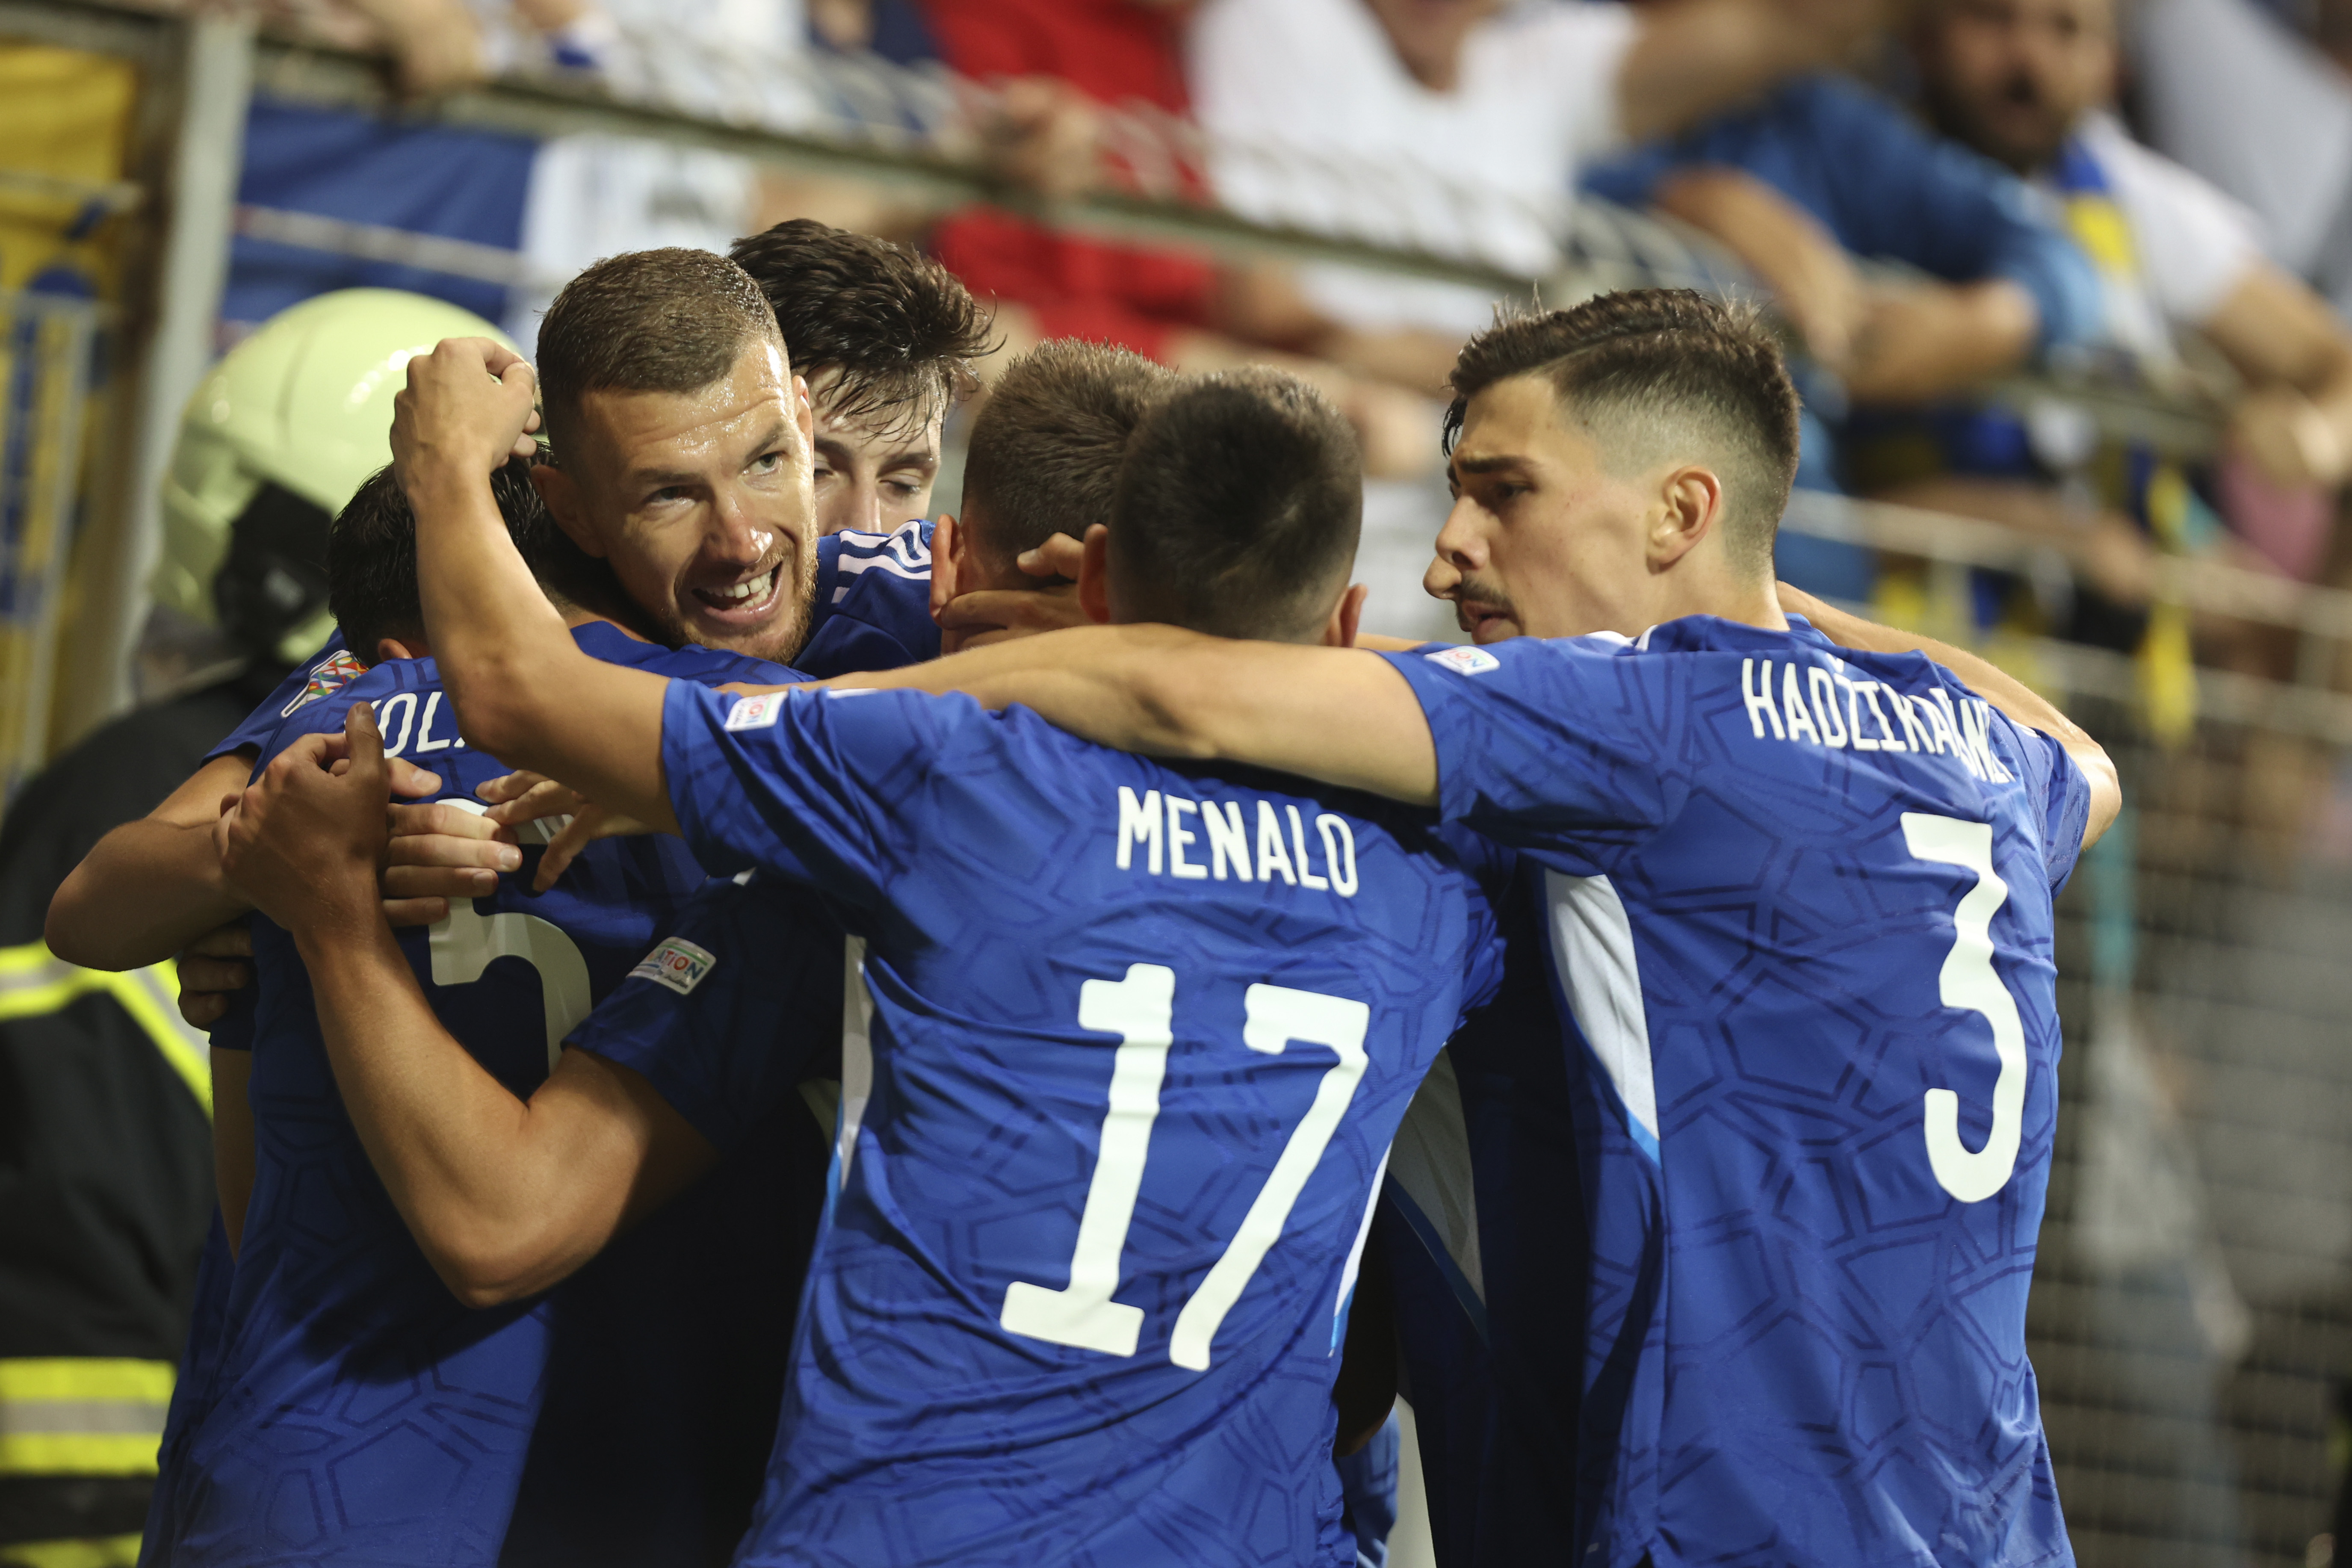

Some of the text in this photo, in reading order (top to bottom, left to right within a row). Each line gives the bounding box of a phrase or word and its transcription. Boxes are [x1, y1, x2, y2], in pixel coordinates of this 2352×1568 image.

[1116, 786, 1359, 897] MENALO
[1900, 812, 2027, 1203] 3
[1000, 963, 1369, 1372] 17
